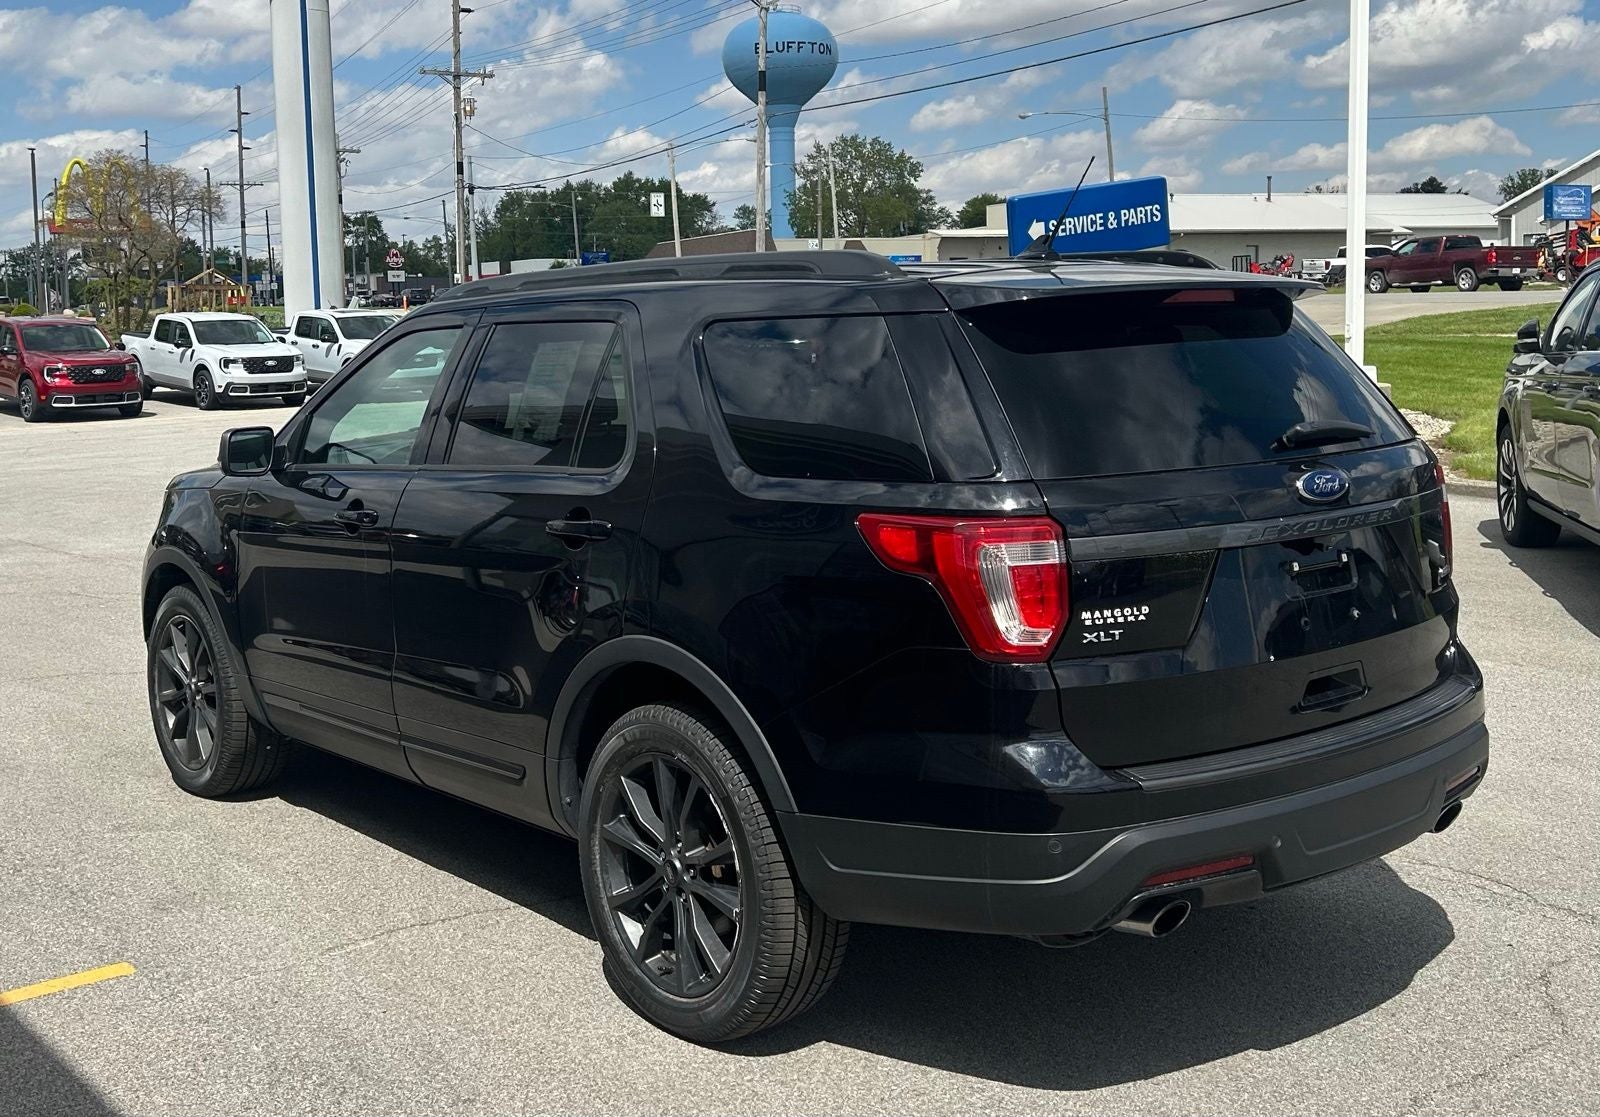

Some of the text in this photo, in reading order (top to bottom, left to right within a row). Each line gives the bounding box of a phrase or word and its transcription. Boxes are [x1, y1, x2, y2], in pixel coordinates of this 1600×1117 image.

[1048, 204, 1162, 237] SERVICE & PARTS
[1313, 474, 1341, 493] Ford
[1261, 509, 1393, 537] EXPLORER
[1081, 605, 1150, 619] MANGOLD
[1084, 614, 1146, 626] EUREKA
[1082, 629, 1124, 643] XLT
